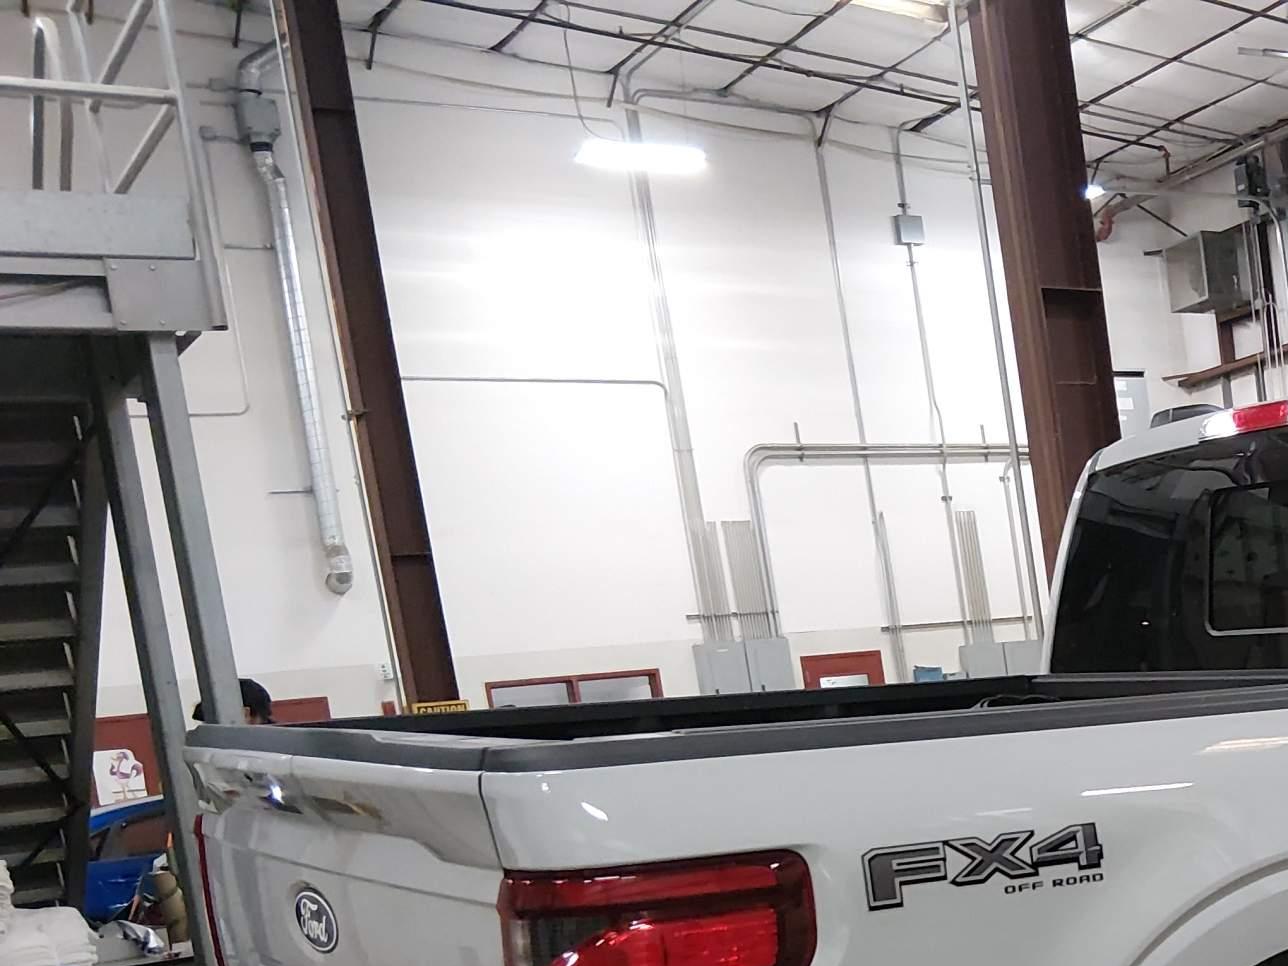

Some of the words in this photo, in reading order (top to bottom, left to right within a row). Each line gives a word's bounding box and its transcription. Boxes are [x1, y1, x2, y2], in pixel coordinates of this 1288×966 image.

[861, 822, 1104, 911] FX4
[1004, 881, 1044, 894] OFF
[1052, 872, 1104, 888] ROAD
[299, 896, 331, 945] Ford
